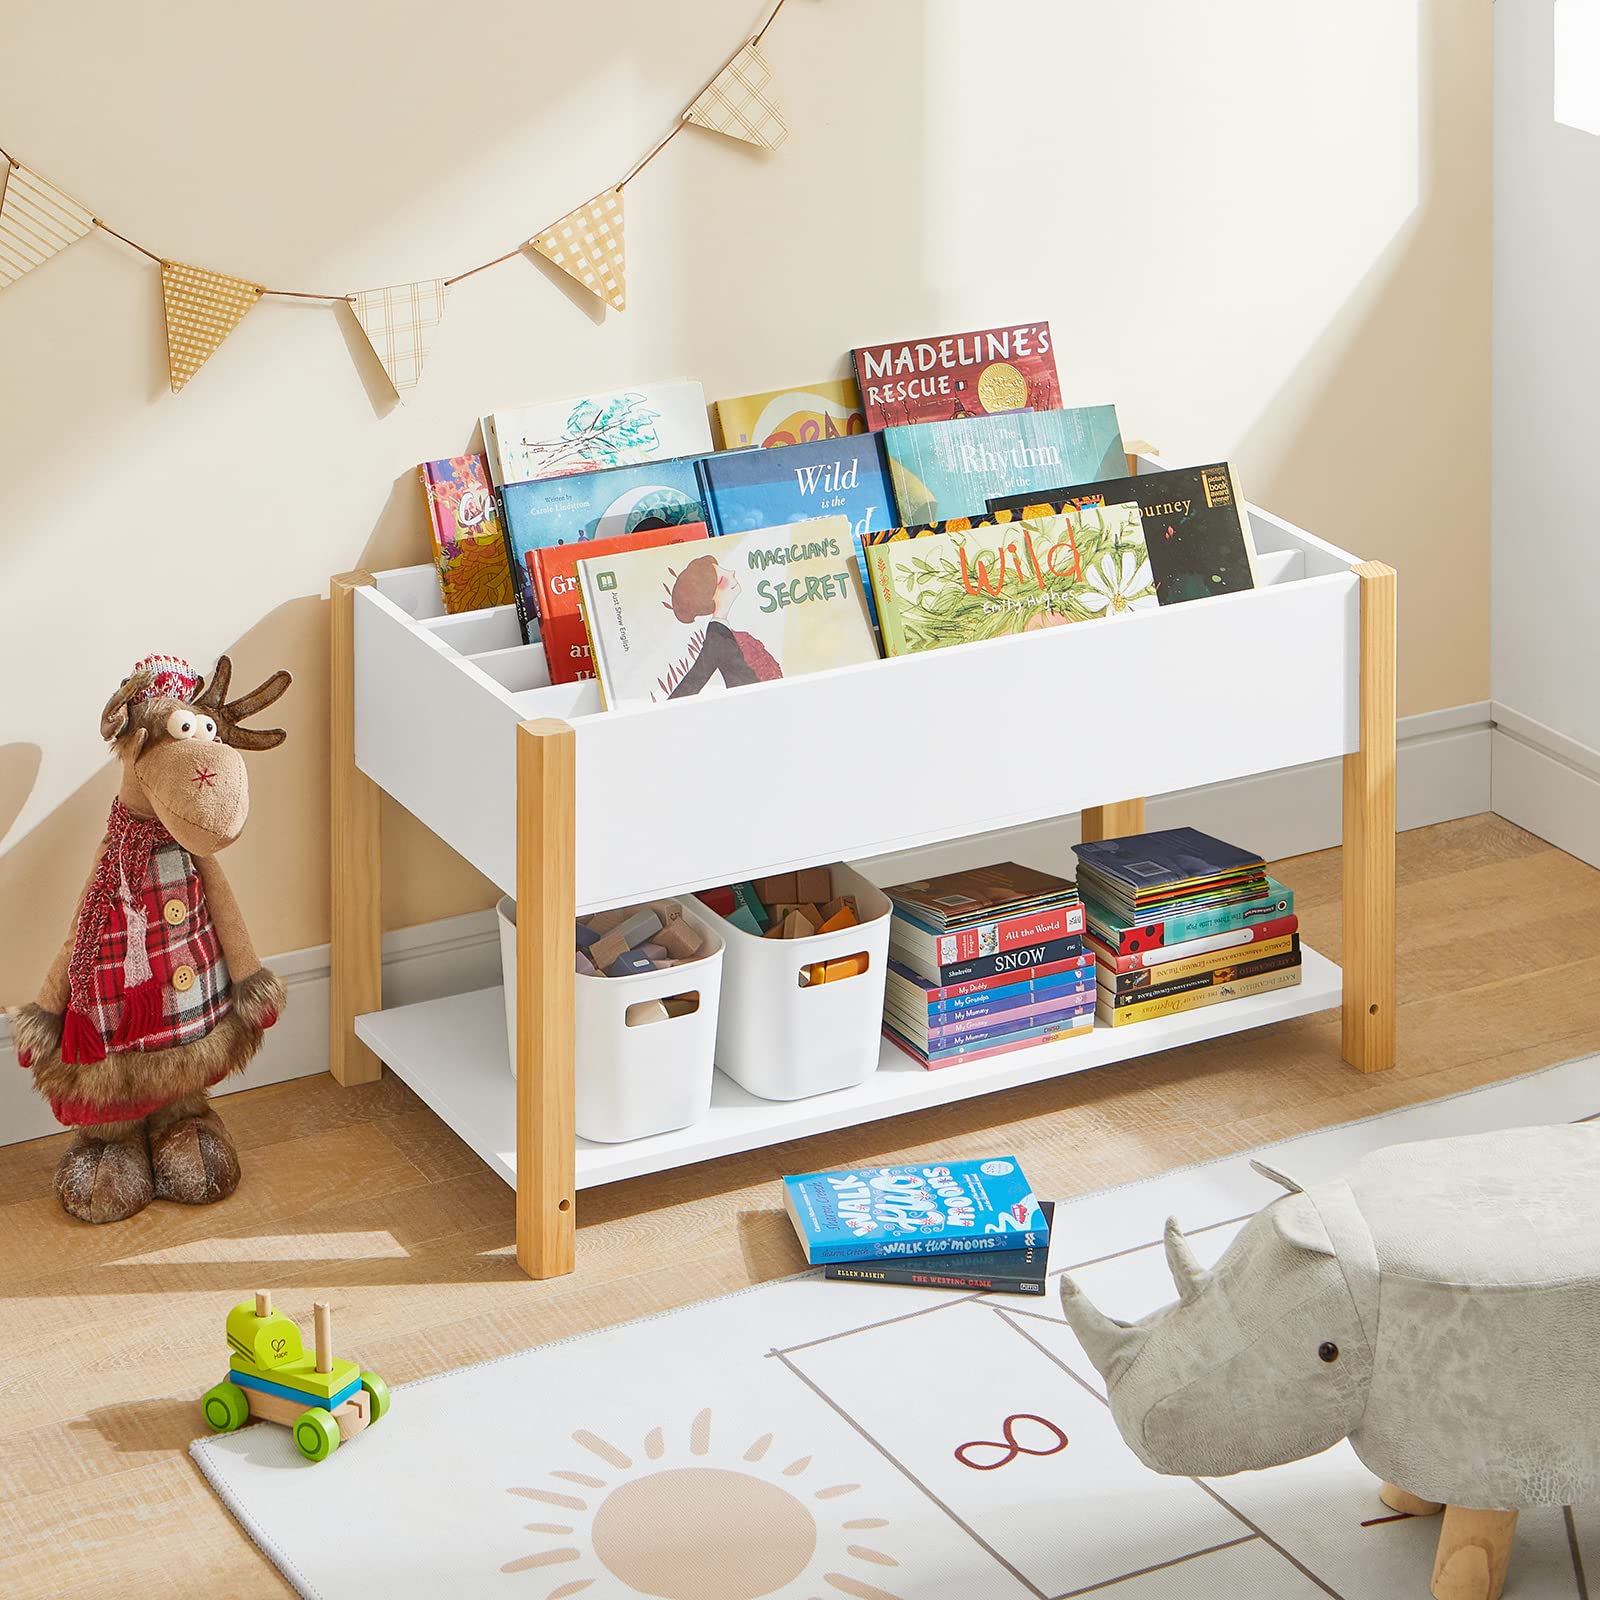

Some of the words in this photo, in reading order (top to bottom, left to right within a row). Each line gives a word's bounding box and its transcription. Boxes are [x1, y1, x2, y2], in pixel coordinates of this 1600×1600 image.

[863, 327, 1050, 379] MADELINE'S
[867, 375, 950, 406] RESCUE
[959, 439, 1062, 479] Rhythm
[794, 458, 859, 497] Wild
[1016, 476, 1031, 487] the
[1209, 481, 1227, 491] book
[530, 505, 554, 516] Carole
[555, 500, 590, 512] Lindstrom
[821, 498, 830, 509] is
[831, 495, 846, 507] the
[1138, 499, 1191, 518] ourney
[747, 538, 841, 571] MAGICIAN'S
[960, 517, 1083, 597] Wild
[756, 572, 850, 613] SECRET
[982, 599, 1023, 614] Emily
[1026, 587, 1076, 609] Hughes
[611, 591, 619, 606] Just
[615, 606, 624, 626] Show
[620, 626, 630, 653] English
[1004, 930, 1019, 942] All
[1021, 927, 1035, 937] the
[1035, 921, 1060, 933] World
[994, 946, 1046, 972] SNOW
[970, 983, 988, 991] Daddy
[954, 1000, 964, 1008] My
[955, 1012, 965, 1020] My
[955, 1024, 965, 1032] My
[954, 1037, 964, 1045] My
[826, 1174, 878, 1237] WALK
[883, 1241, 923, 1254] WALK
[925, 1239, 950, 1252] two
[837, 1269, 858, 1277] ELLEN
[860, 1271, 885, 1279] RASKIN
[912, 1275, 927, 1283] THE
[929, 1276, 965, 1286] WESTING
[968, 1279, 992, 1288] GAME
